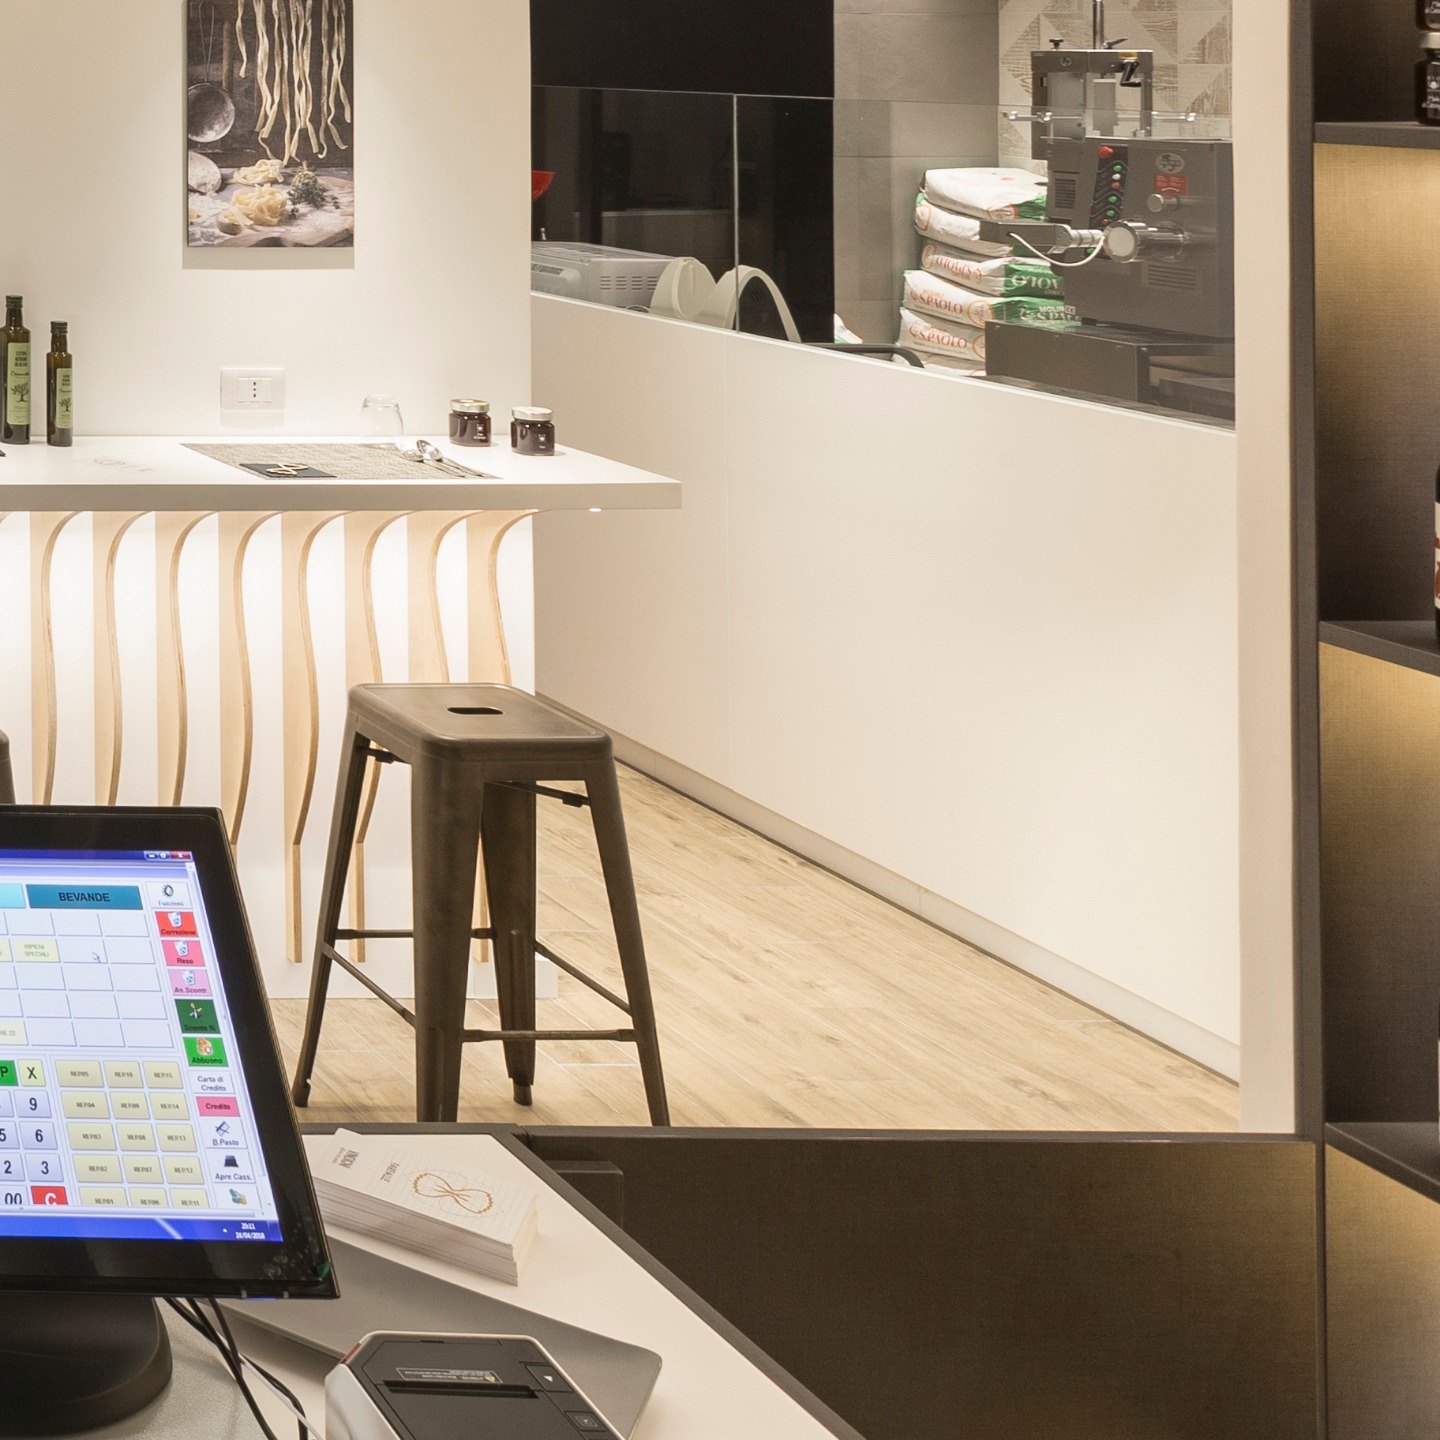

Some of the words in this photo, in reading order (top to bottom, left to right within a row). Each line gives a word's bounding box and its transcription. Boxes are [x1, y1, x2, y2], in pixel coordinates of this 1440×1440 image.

[58, 892, 110, 902] BEVANDE
[160, 928, 196, 936] Correzione
[0, 1066, 9, 1078] P
[26, 1066, 38, 1080] X
[197, 1076, 216, 1084] Carta
[217, 1076, 224, 1084] di
[201, 1084, 226, 1092] Credito
[28, 1097, 38, 1111] 9
[205, 1102, 231, 1110] Credito
[34, 1128, 44, 1143] 6
[4, 1160, 12, 1174] 2
[40, 1160, 50, 1175] 3
[215, 1172, 233, 1182] Apre
[234, 1172, 252, 1181] Cass.
[4, 1192, 22, 1205] 00
[44, 1192, 57, 1205] C
